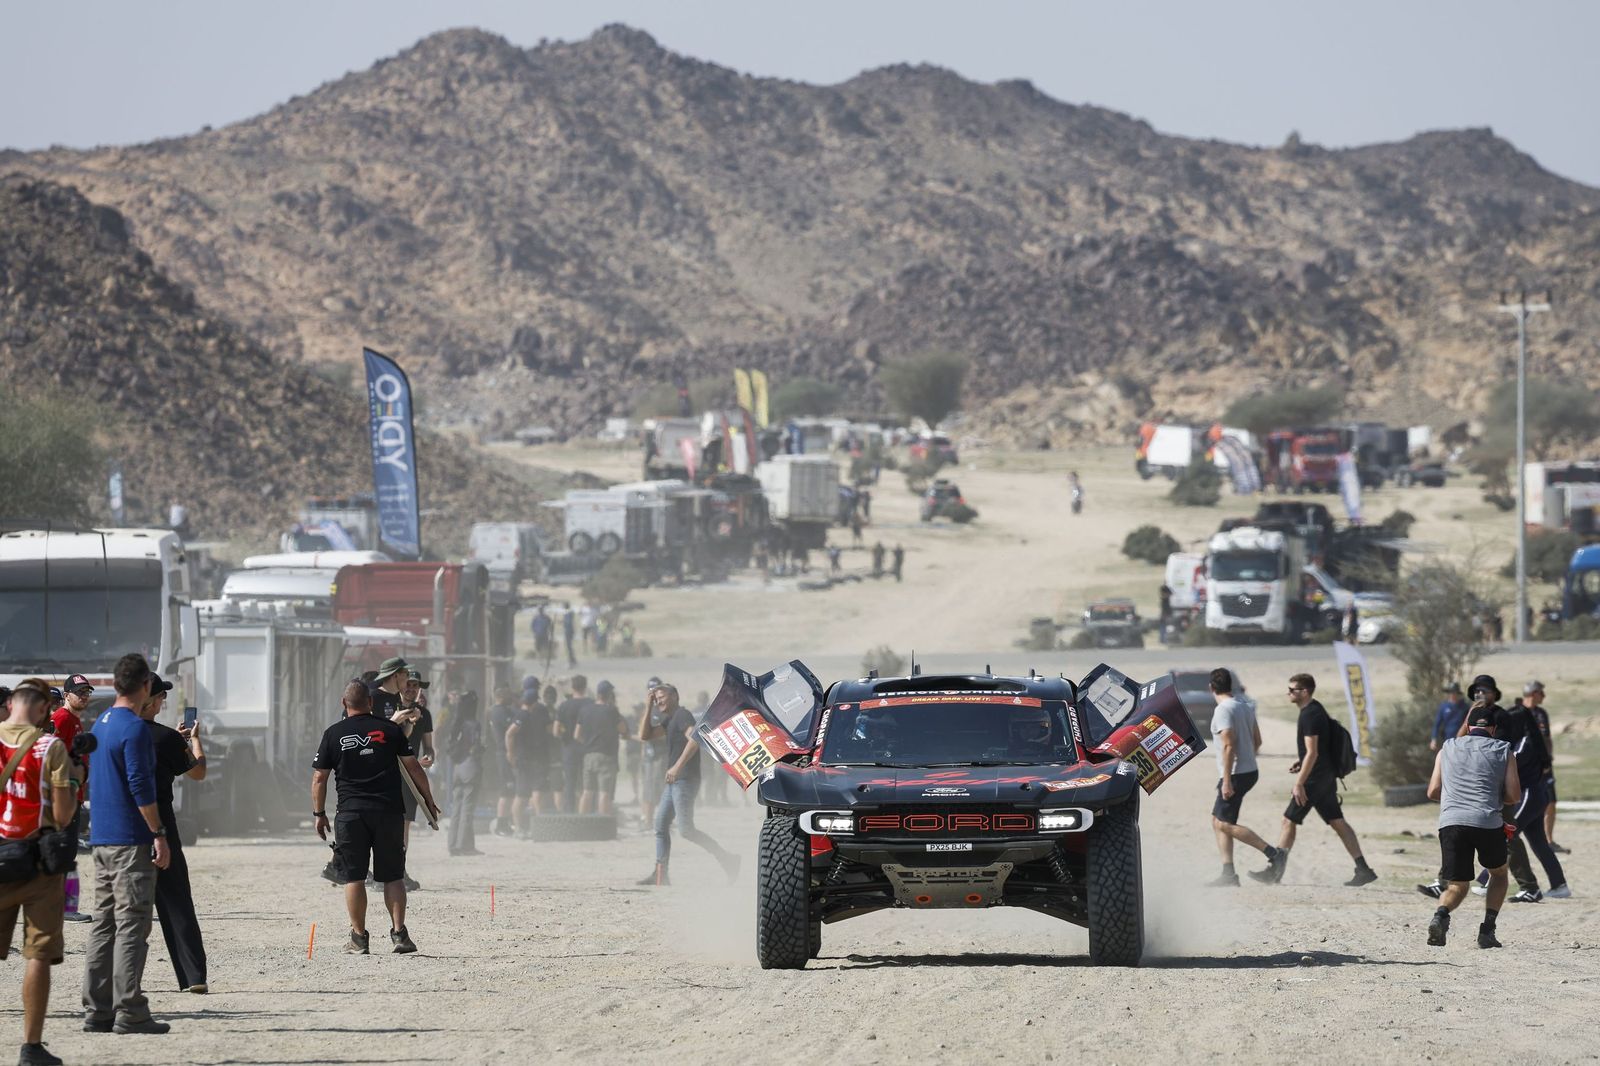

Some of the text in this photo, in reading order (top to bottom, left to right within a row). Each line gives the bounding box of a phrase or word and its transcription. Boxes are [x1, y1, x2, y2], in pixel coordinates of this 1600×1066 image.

[816, 709, 831, 746] CHOPARD
[1069, 706, 1082, 742] CHOPARD
[340, 731, 386, 751] SVR
[716, 736, 734, 758] TUDOR
[724, 726, 746, 750] MOTUL
[1154, 738, 1178, 760] MOTUL
[742, 744, 771, 776] 236
[1165, 749, 1185, 768] TUDOR
[858, 814, 1035, 832] FORD
